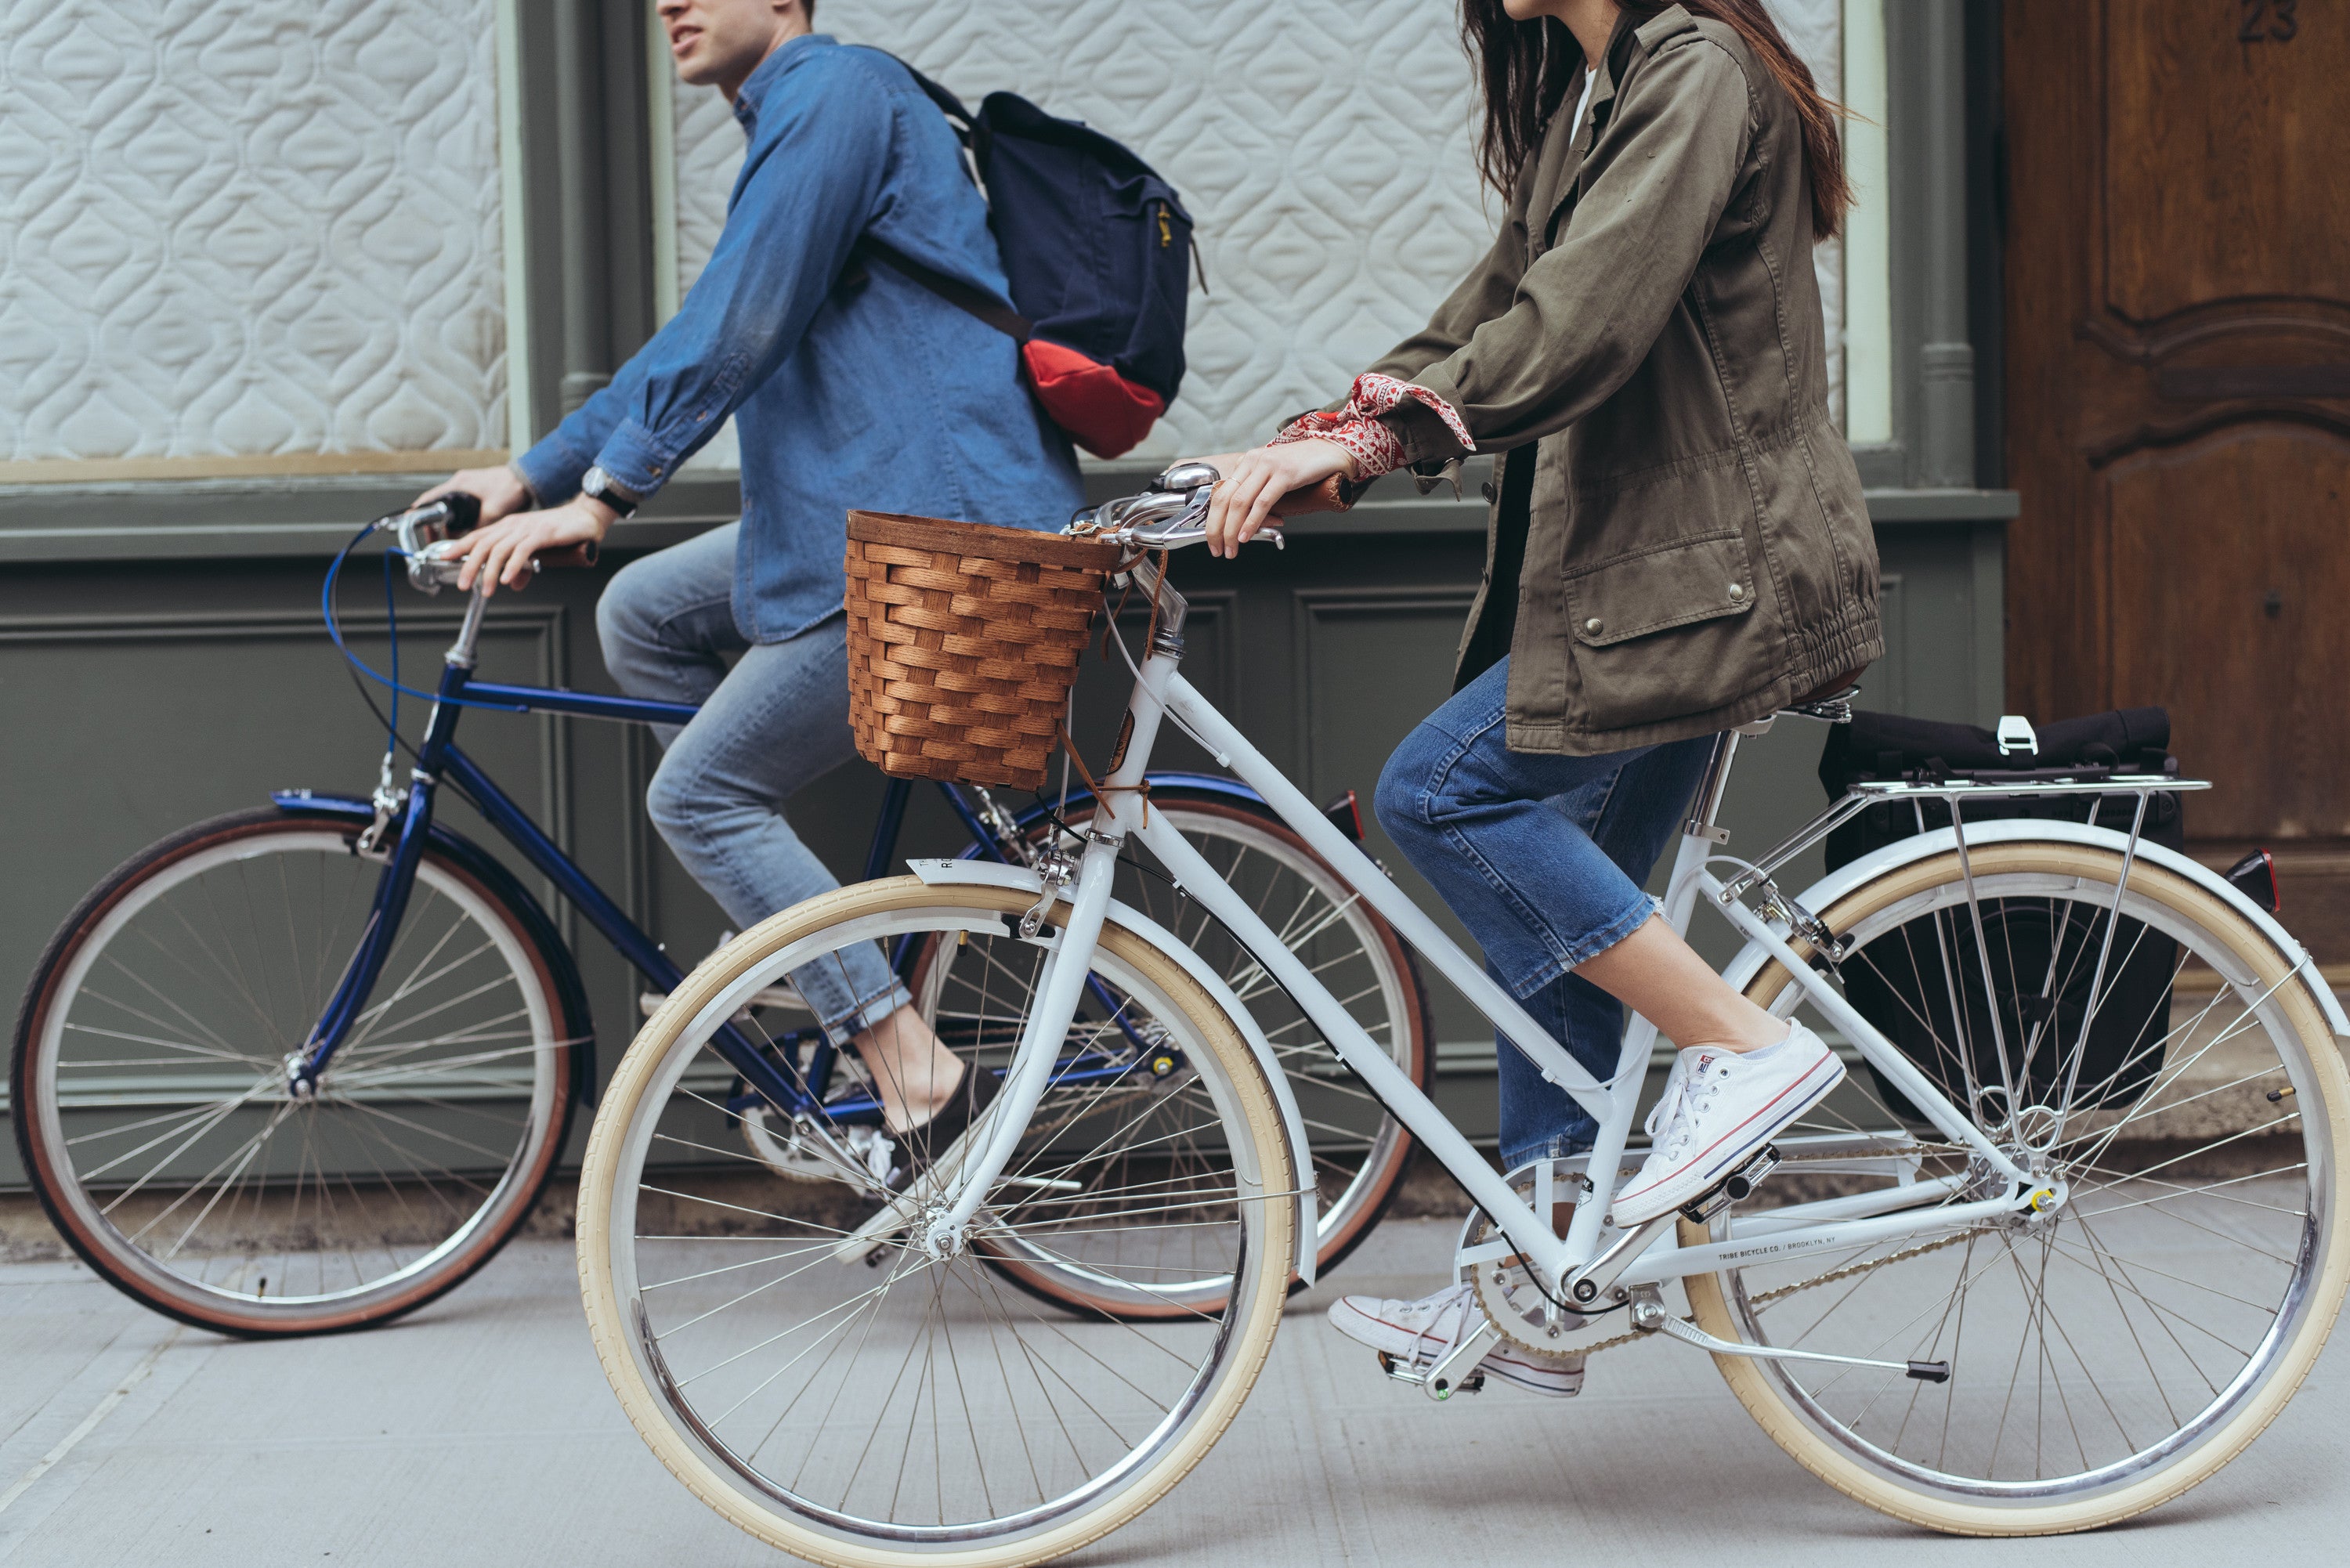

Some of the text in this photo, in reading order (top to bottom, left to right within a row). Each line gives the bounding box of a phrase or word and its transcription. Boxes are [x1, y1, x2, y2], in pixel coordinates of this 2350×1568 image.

[2239, 0, 2298, 42] 23
[1719, 1252, 1739, 1261] TRIBE
[1740, 1247, 1768, 1258] BICYCLE
